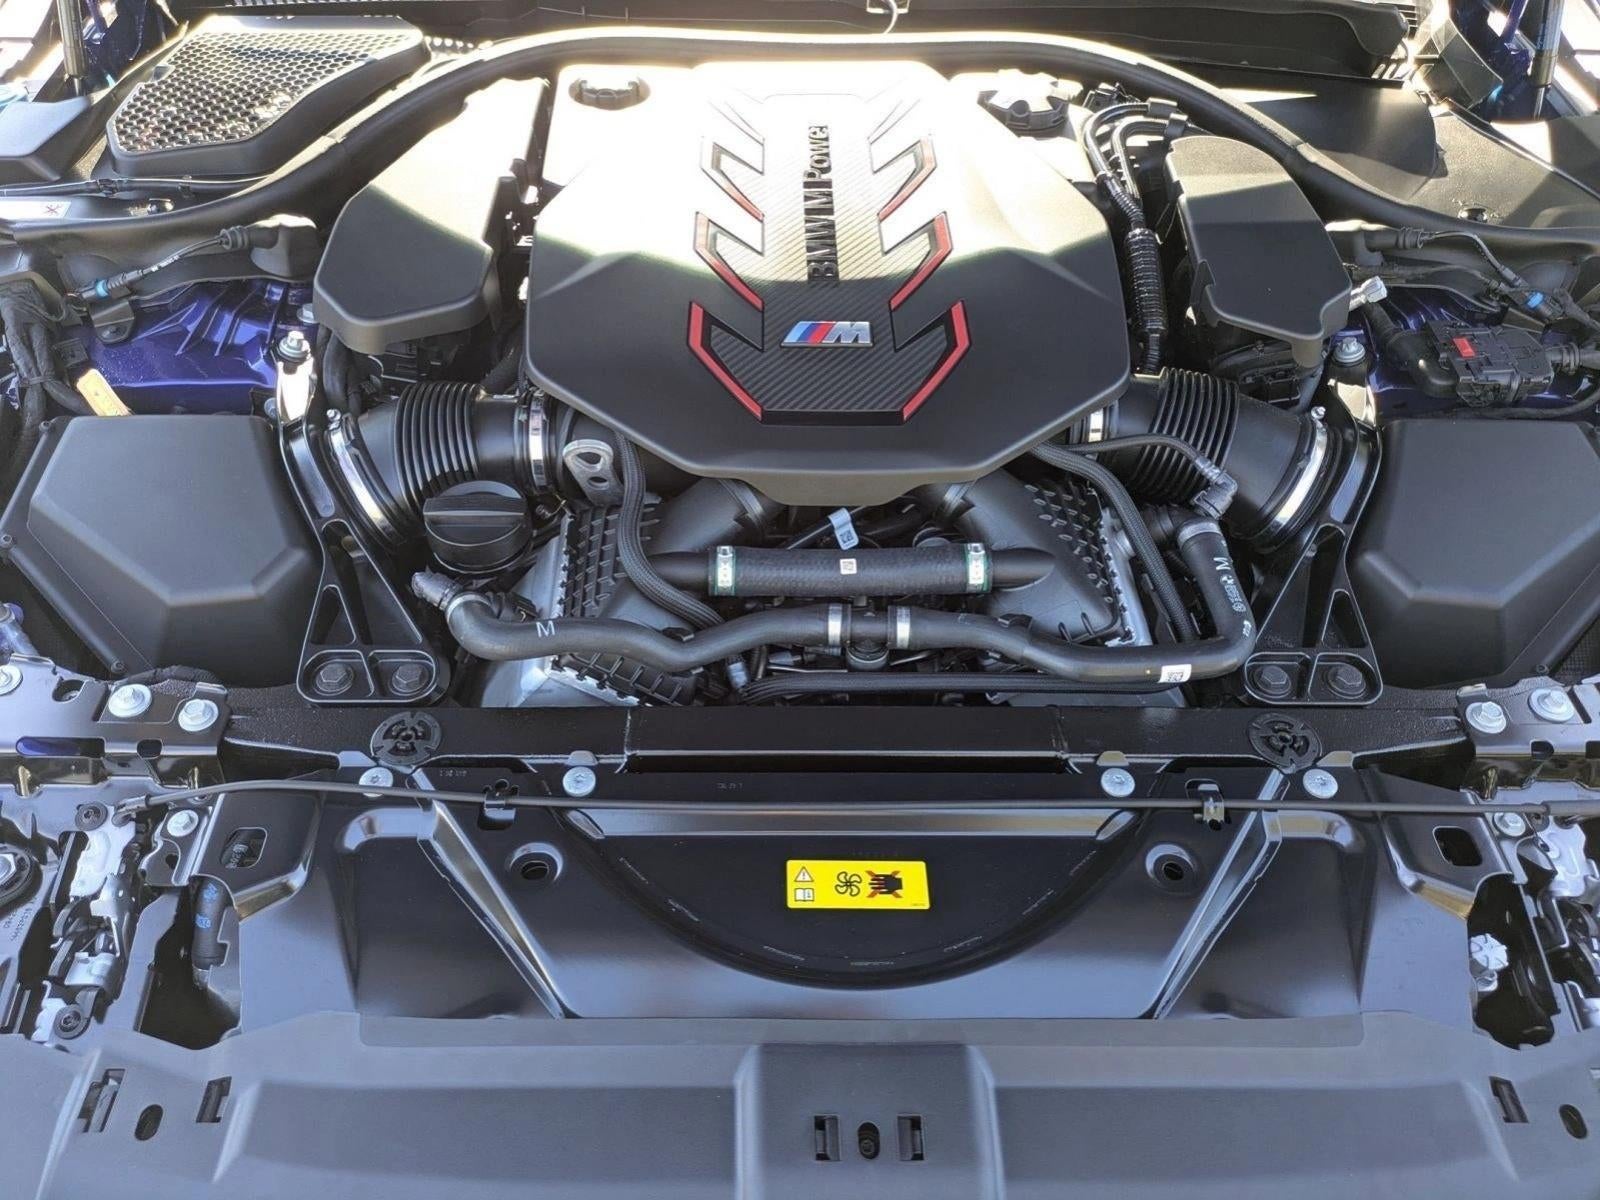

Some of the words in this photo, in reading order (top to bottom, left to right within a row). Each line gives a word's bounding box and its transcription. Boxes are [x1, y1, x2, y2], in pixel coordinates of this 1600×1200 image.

[803, 188, 834, 215] M
[804, 216, 838, 282] BMW
[821, 321, 873, 346] M
[535, 620, 556, 638] M
